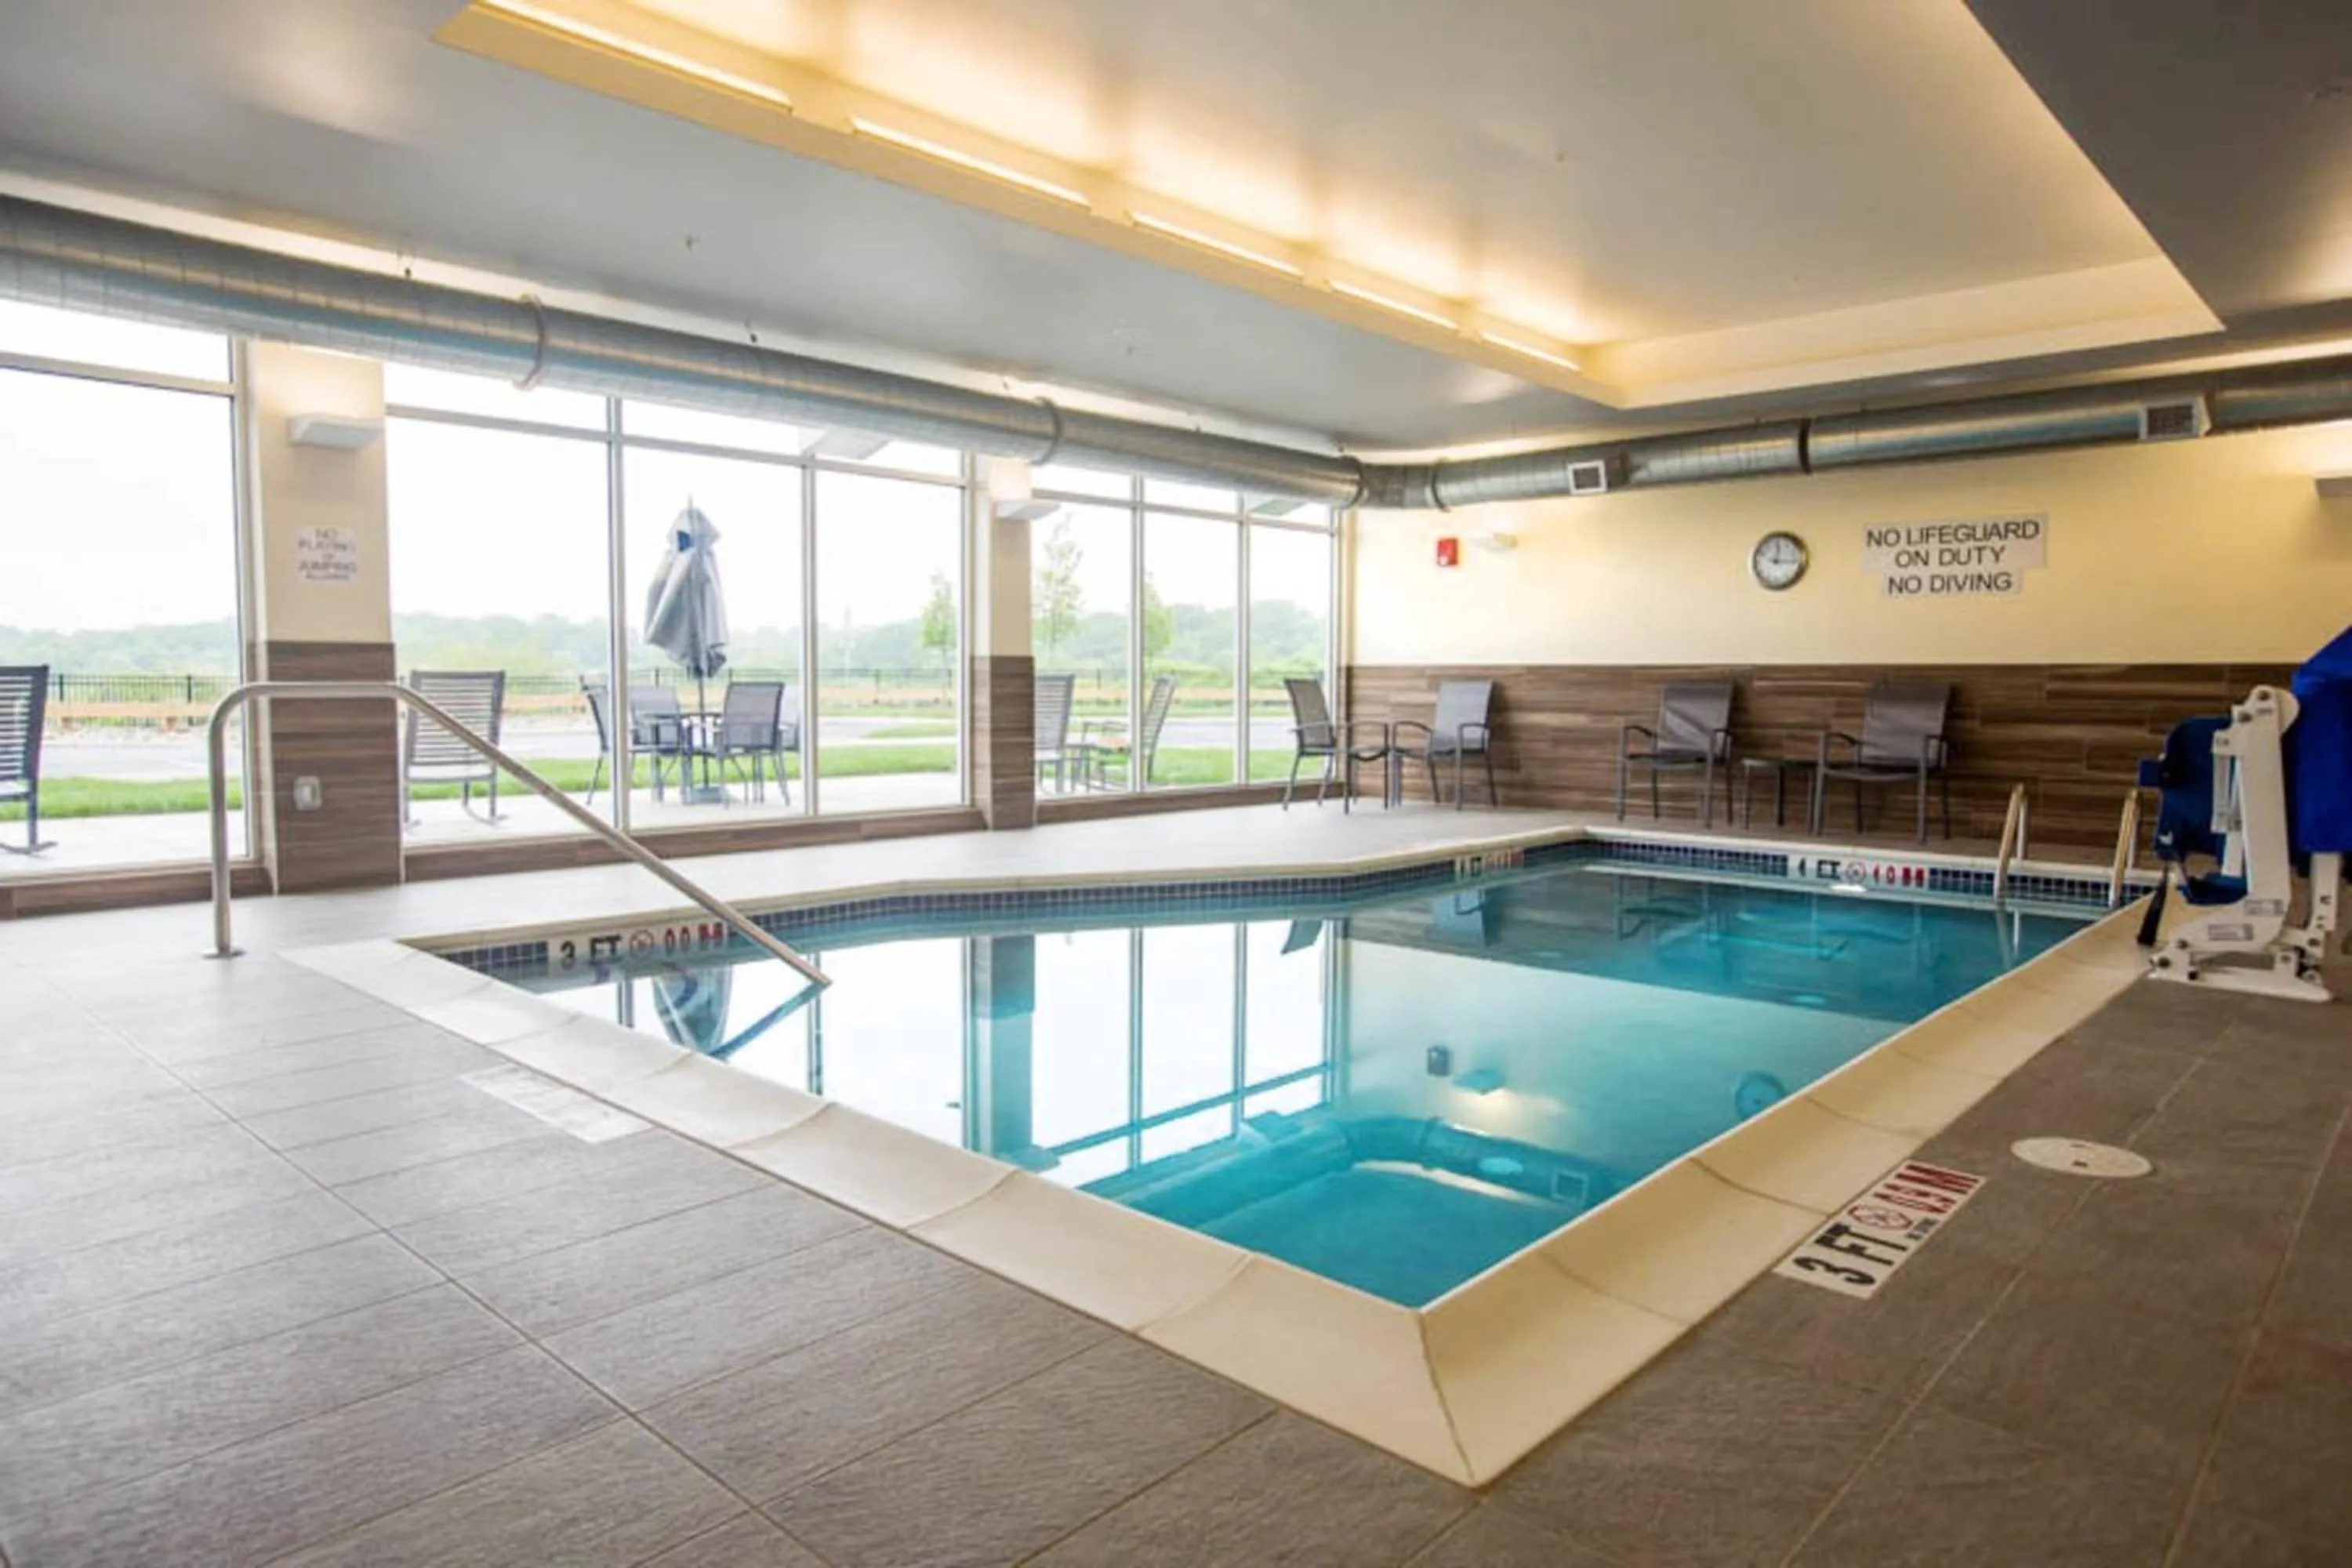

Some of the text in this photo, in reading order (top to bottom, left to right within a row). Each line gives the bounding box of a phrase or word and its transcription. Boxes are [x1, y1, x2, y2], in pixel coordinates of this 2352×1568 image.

[1867, 520, 2041, 547] NO LIFEGUARD
[1895, 546, 2005, 568] ON DUTY
[1888, 572, 2013, 594] NO DIVING
[1813, 1222, 1908, 1267] FT
[1792, 1255, 1876, 1286] 3
